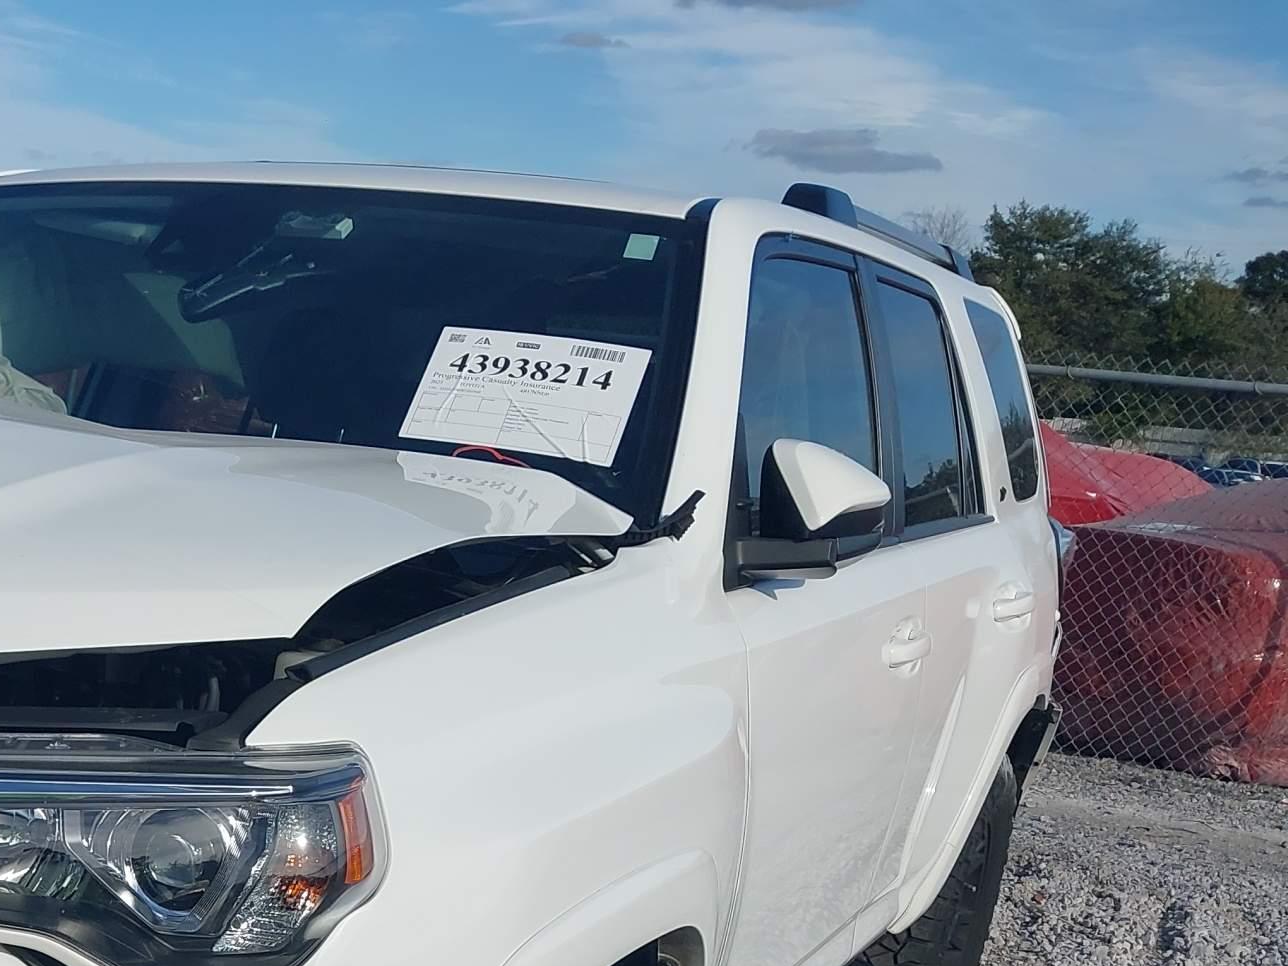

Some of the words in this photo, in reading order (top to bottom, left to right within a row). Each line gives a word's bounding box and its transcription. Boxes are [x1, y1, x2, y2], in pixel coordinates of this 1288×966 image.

[432, 371, 480, 382] Progressive
[481, 376, 518, 388] Casualty
[520, 380, 561, 392] Insurance
[449, 352, 614, 391] 43938214
